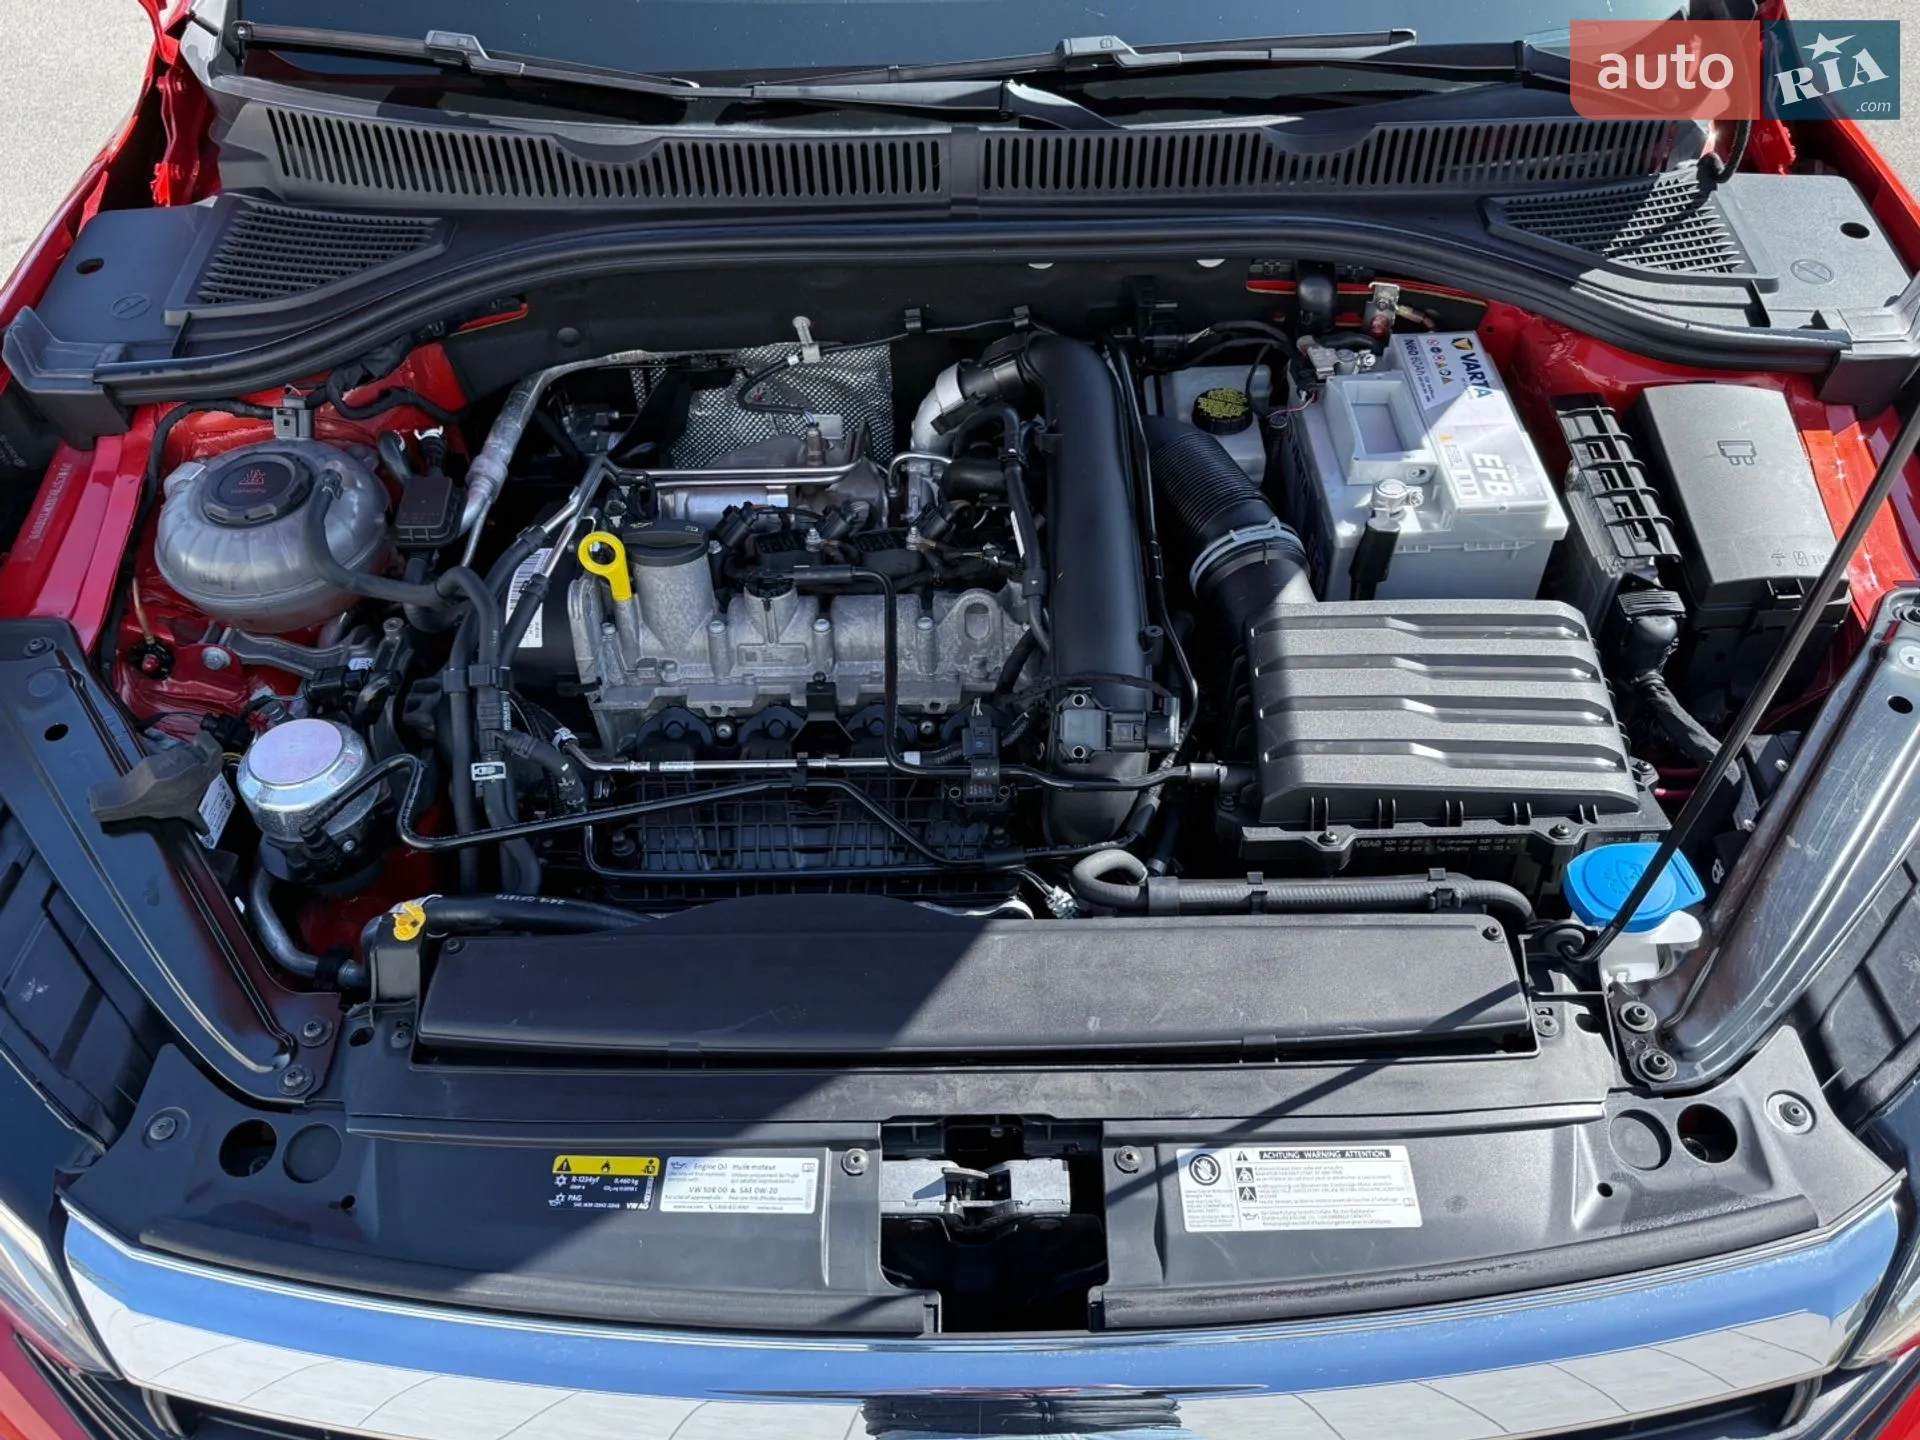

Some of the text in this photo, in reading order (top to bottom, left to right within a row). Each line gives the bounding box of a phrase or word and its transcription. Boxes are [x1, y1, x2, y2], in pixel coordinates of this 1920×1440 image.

[1461, 352, 1493, 398] VARTA
[1472, 453, 1517, 496] EFB
[1262, 1150, 1387, 1160] ACHTUNG WARNING ATTENTION
[694, 1163, 717, 1172] Engine
[568, 1194, 582, 1202] PAG
